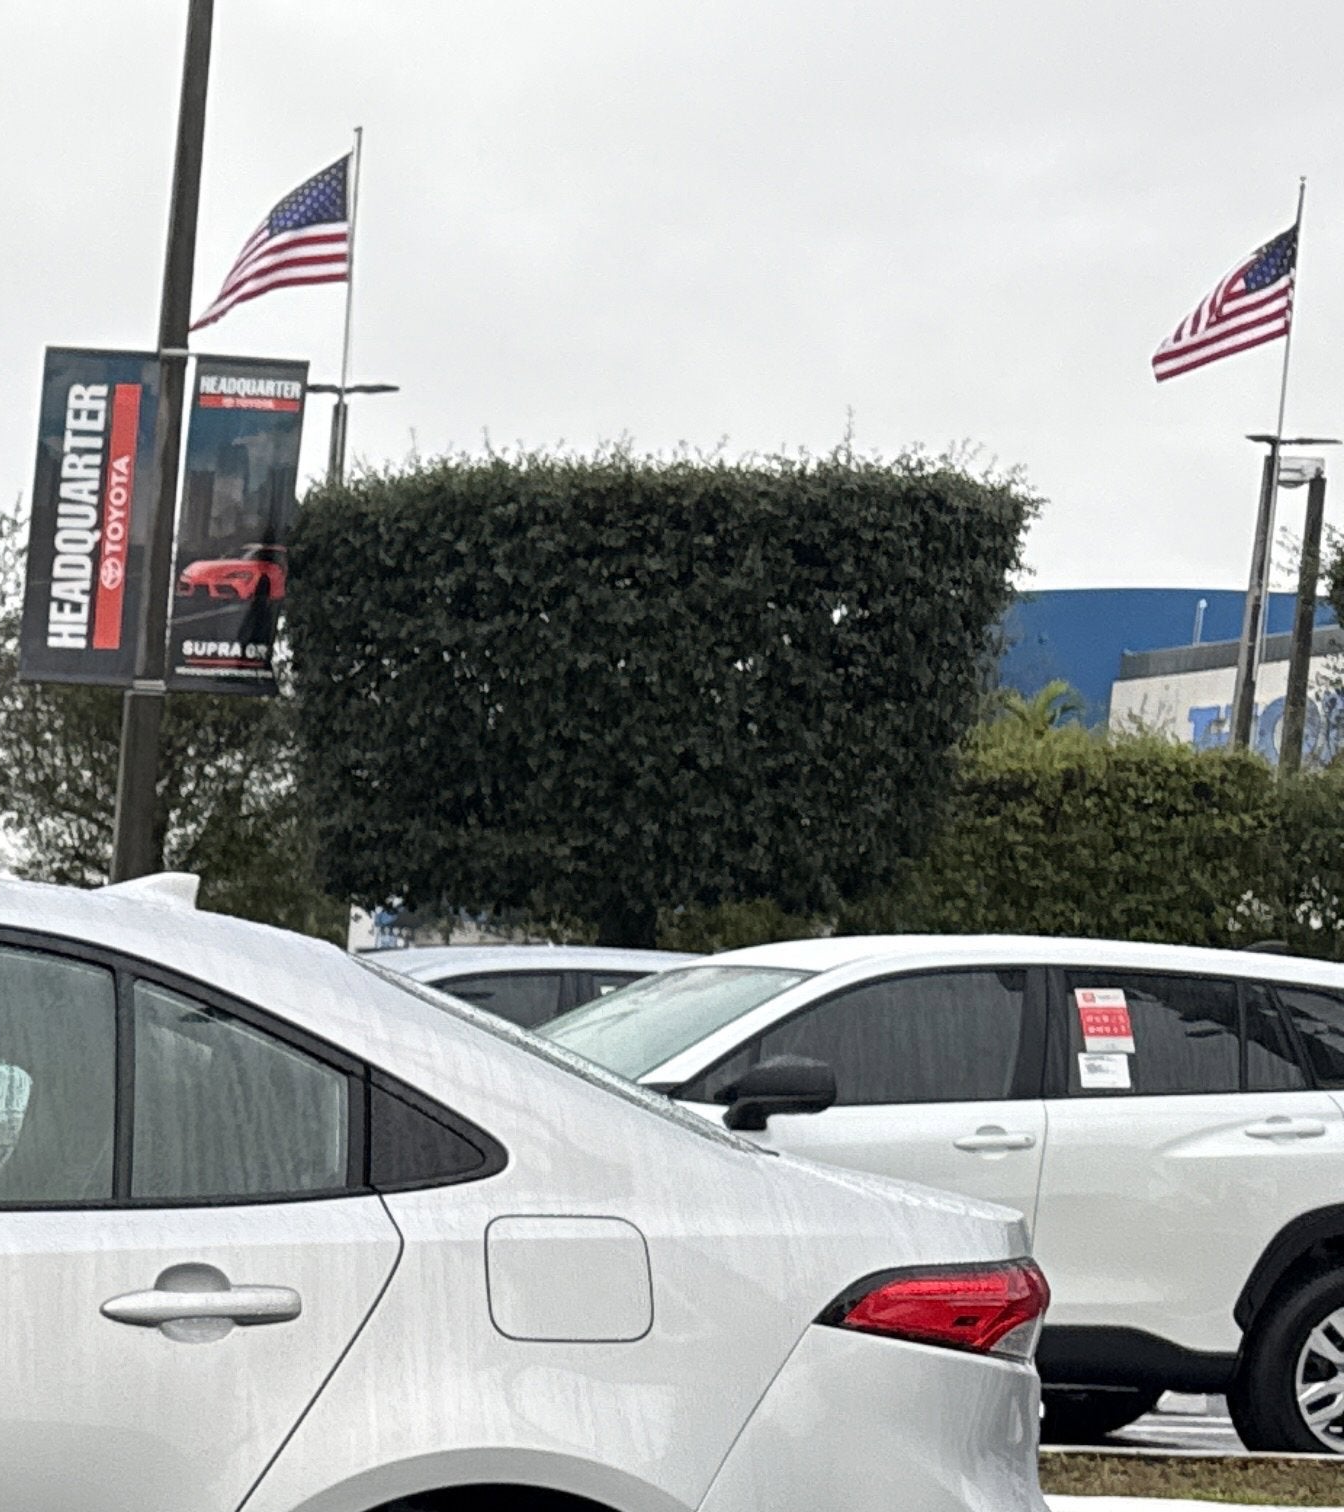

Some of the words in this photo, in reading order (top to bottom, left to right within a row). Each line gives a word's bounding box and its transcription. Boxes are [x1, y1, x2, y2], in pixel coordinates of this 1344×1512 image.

[200, 376, 301, 399] HEADQUARTER
[47, 383, 109, 649] HEADQUARTER
[104, 455, 131, 552] TOYOTA
[182, 640, 242, 657] SUPRA
